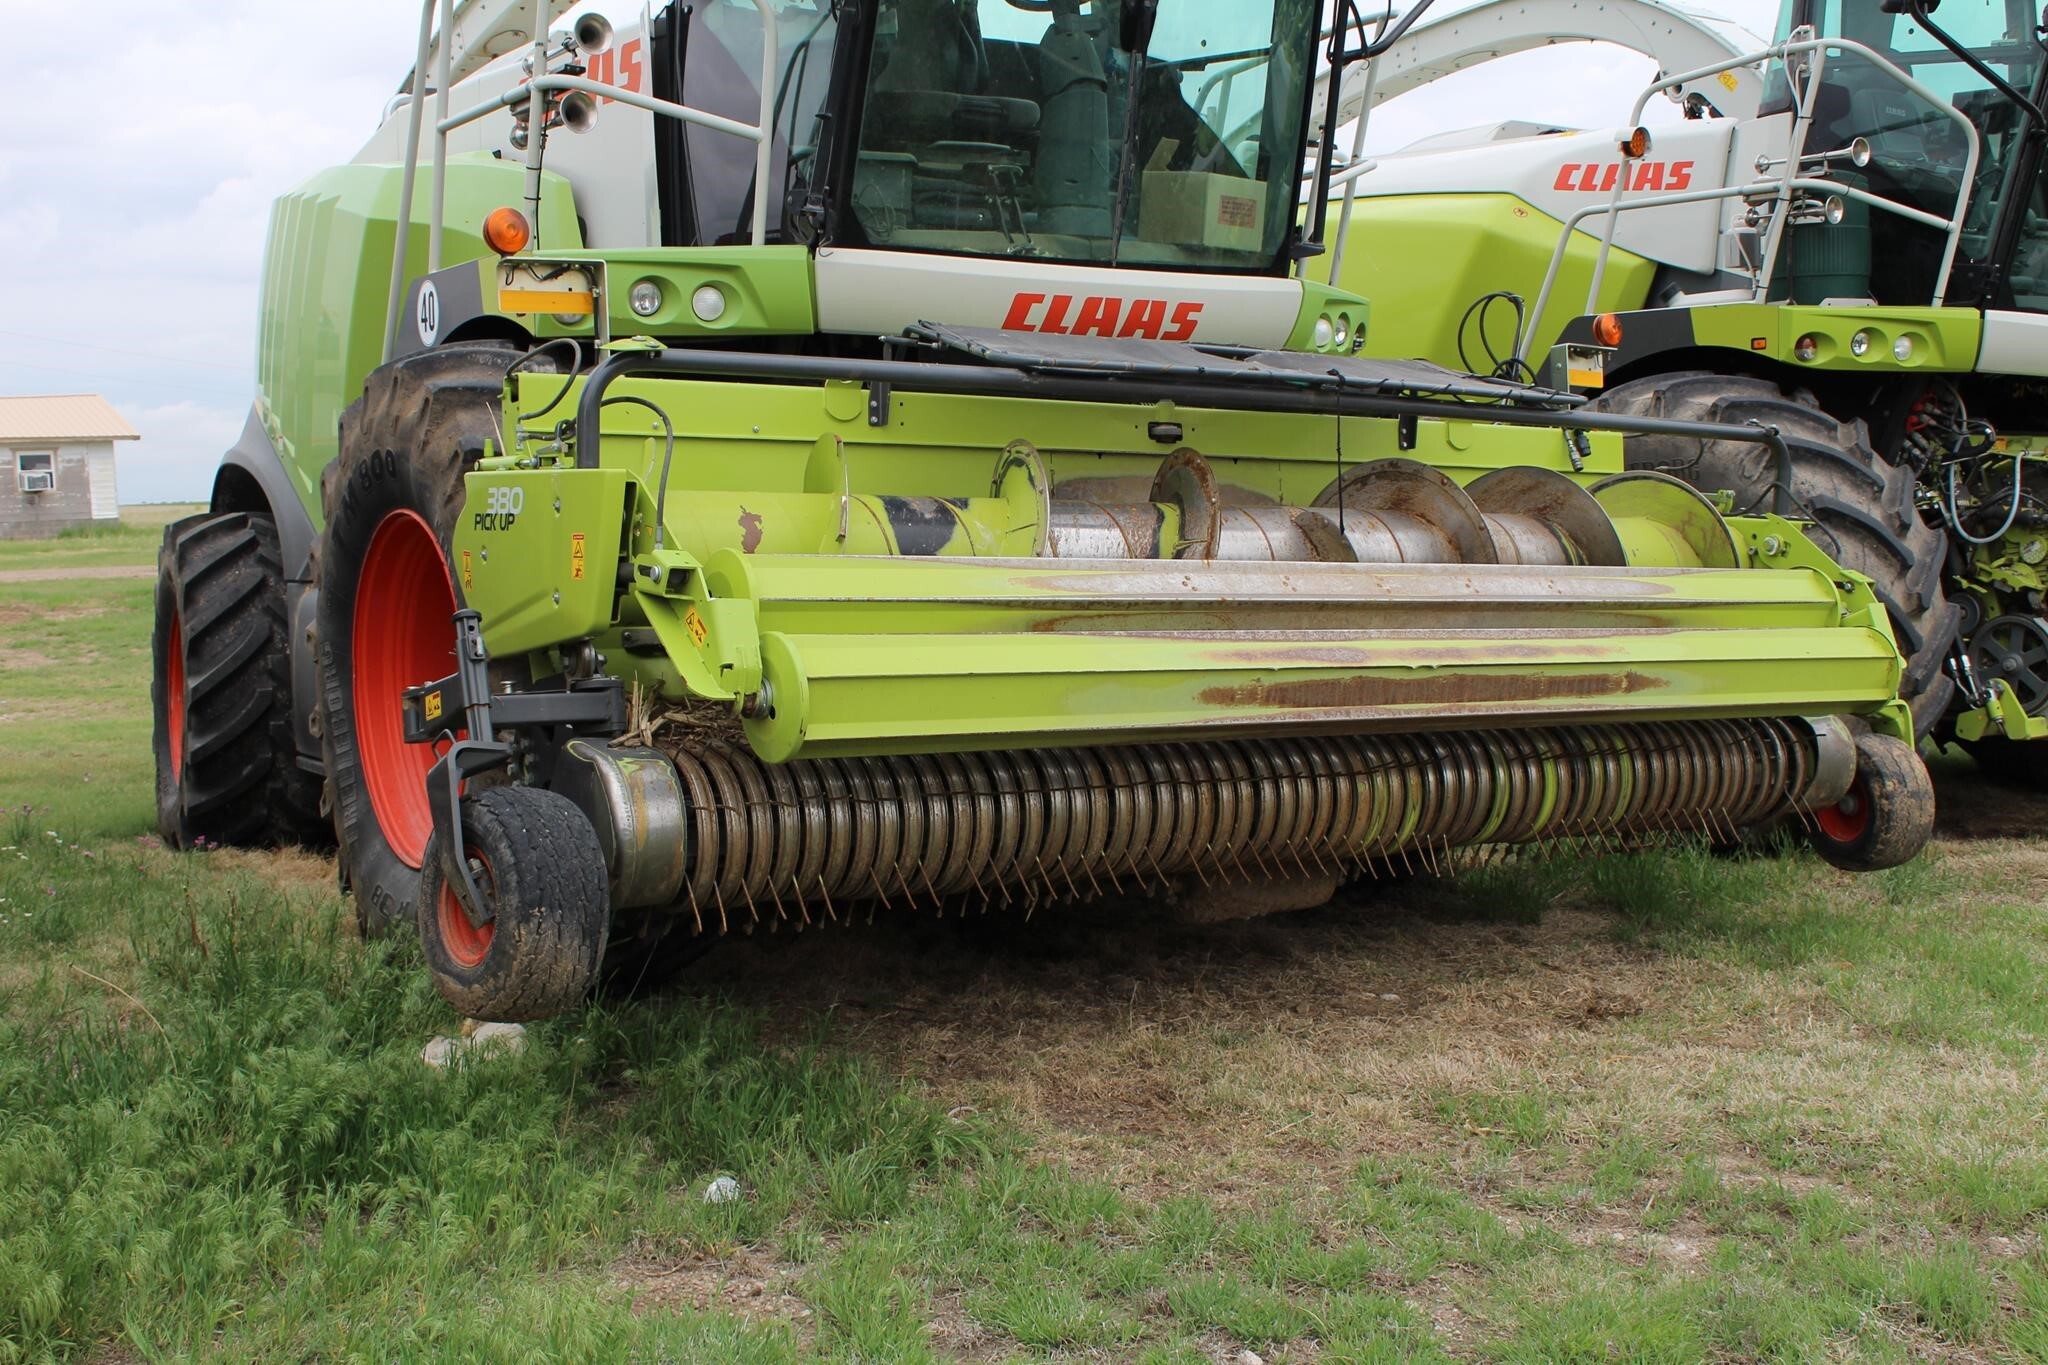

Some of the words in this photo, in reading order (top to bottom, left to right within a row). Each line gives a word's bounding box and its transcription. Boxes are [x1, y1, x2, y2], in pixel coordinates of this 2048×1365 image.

[1553, 161, 1694, 191] CLAAS
[421, 291, 435, 333] 40
[1001, 292, 1204, 341] CLAAS
[359, 448, 398, 492] 800
[486, 486, 524, 515] 380
[474, 513, 497, 531] PICK
[499, 513, 515, 531] UP
